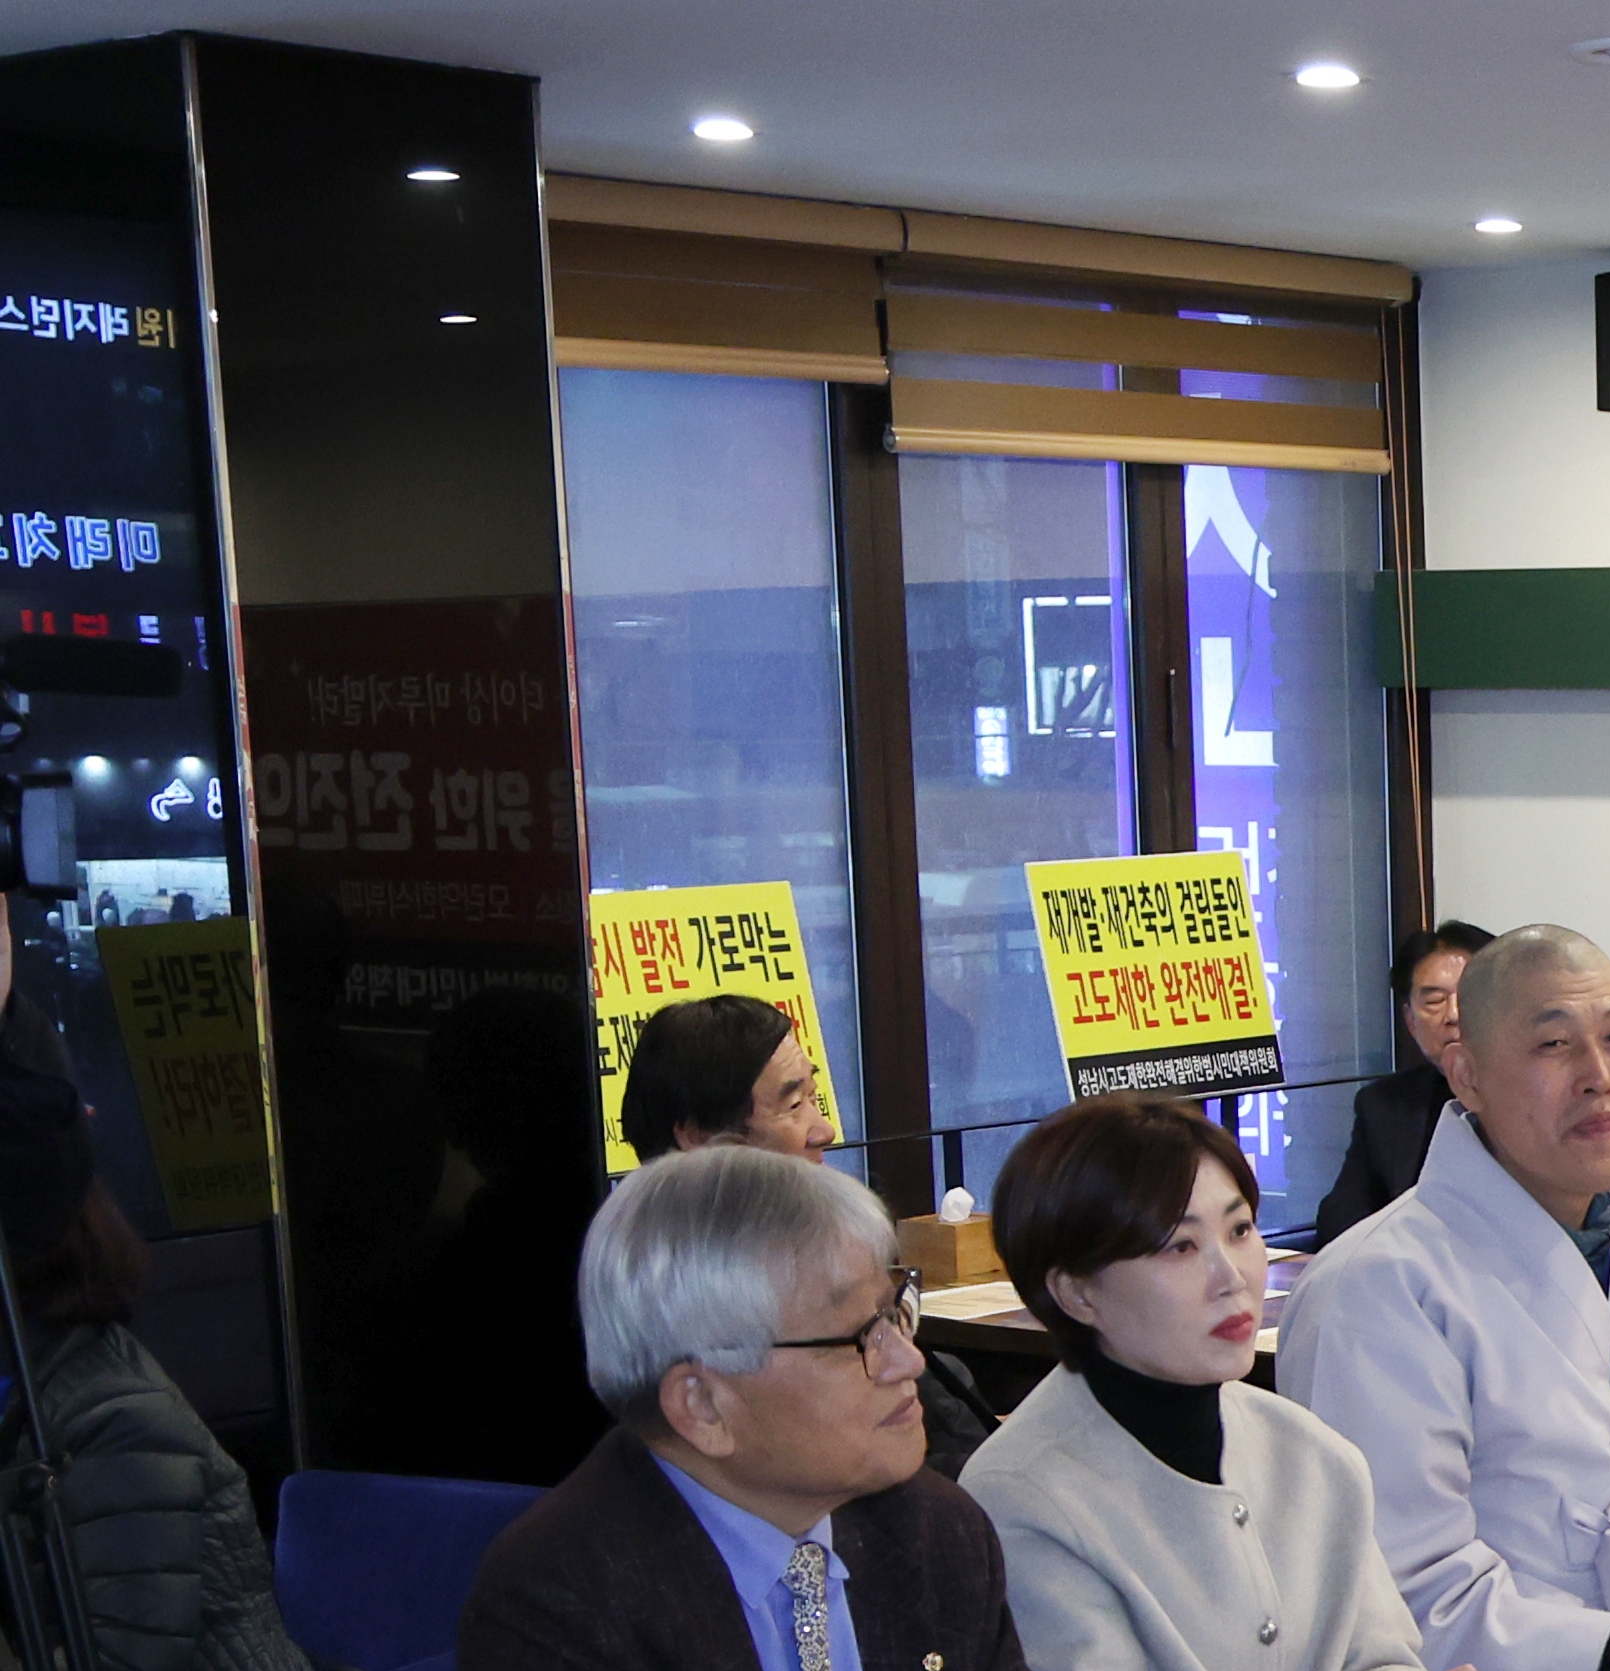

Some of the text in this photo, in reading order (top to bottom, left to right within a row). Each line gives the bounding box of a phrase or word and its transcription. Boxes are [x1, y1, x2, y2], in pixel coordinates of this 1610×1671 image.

[1176, 876, 1250, 944] 걸림돌인
[629, 918, 690, 994] 발전
[688, 911, 795, 987] 가로막는
[1066, 951, 1258, 1030] 고도제한 완전해결!
